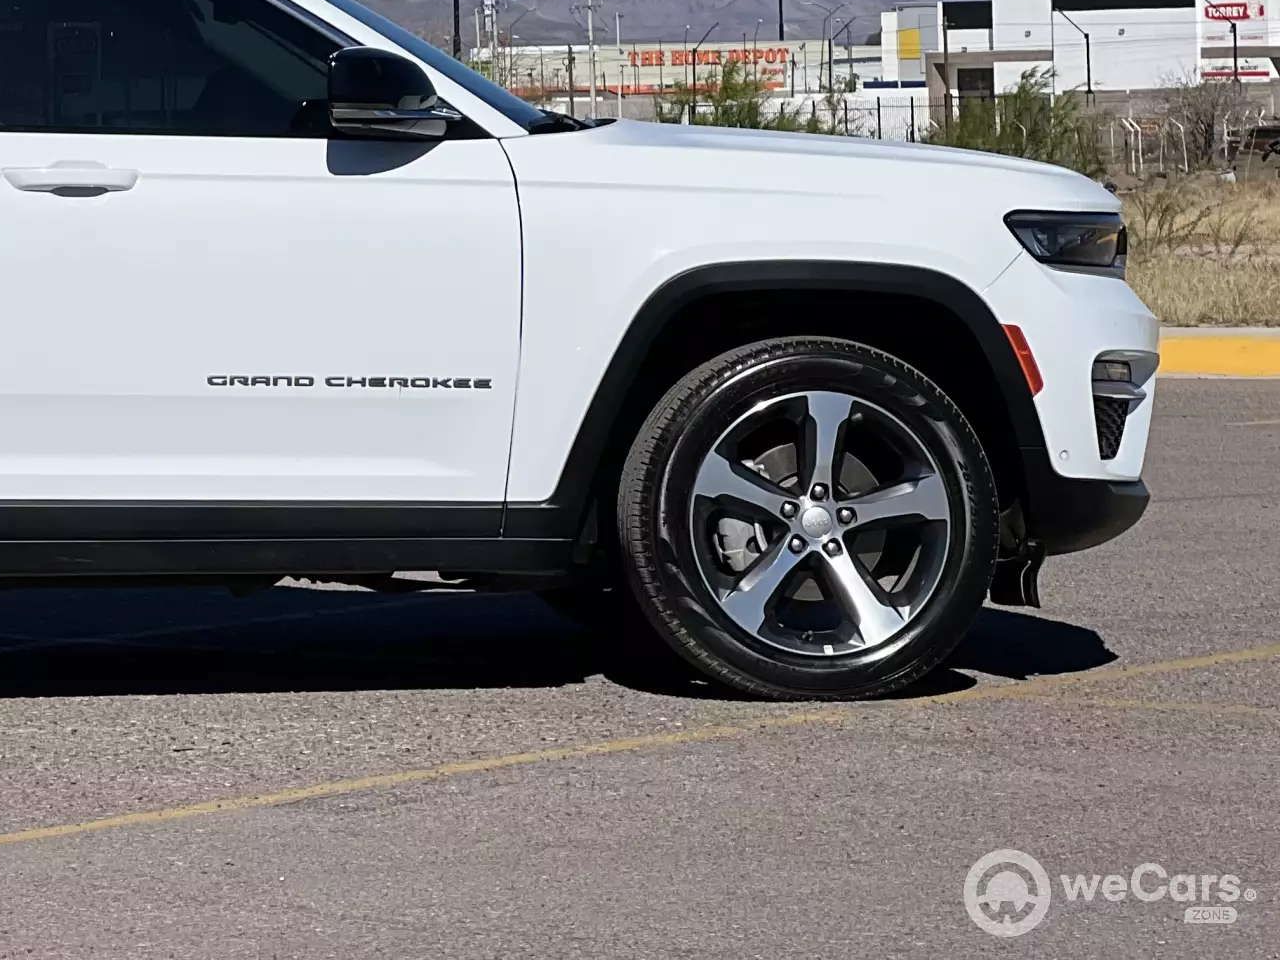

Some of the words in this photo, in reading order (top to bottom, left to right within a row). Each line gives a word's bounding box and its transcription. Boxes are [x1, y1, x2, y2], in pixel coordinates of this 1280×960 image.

[1207, 6, 1245, 17] TORREY
[628, 51, 665, 67] THE
[671, 50, 721, 66] HOME
[728, 48, 789, 66] DEPOT
[206, 375, 315, 387] GRAND
[324, 376, 492, 389] CHEROKEE
